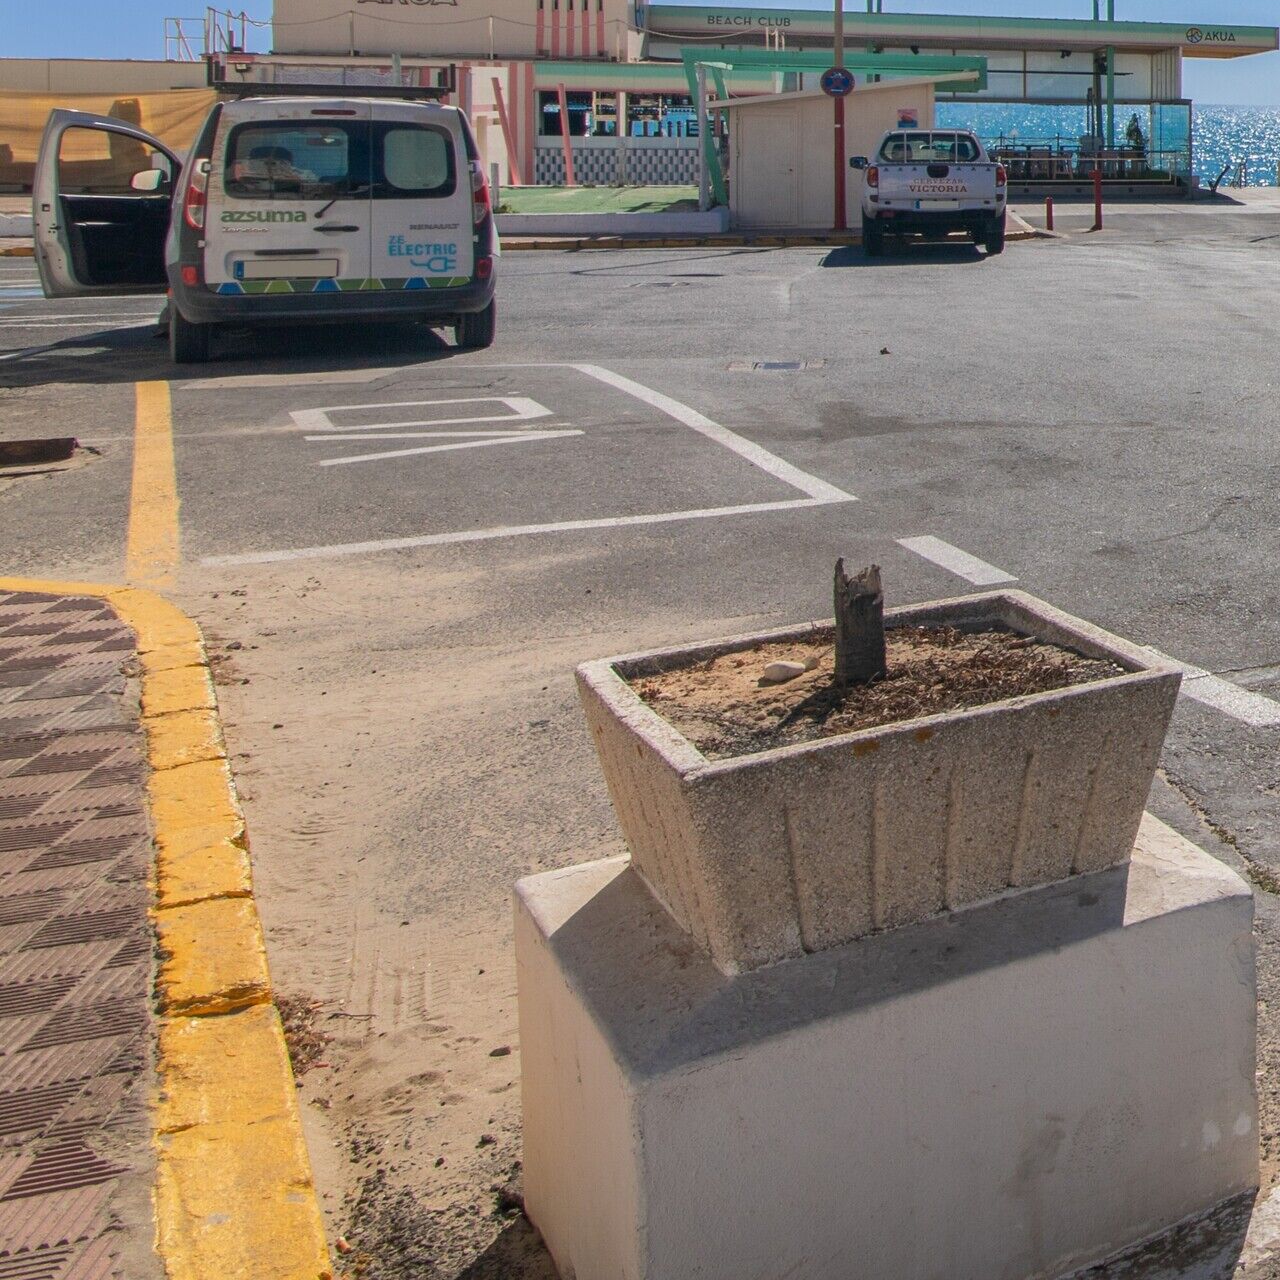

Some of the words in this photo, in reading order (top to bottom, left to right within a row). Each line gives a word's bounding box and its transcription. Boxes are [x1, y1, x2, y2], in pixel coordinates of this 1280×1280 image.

[707, 15, 752, 26] BEACH
[758, 16, 791, 27] CLUB
[1204, 31, 1236, 42] AKUA
[909, 185, 968, 193] VICTORIA
[221, 211, 307, 223] azsuma
[388, 244, 457, 256] ELECTRIC
